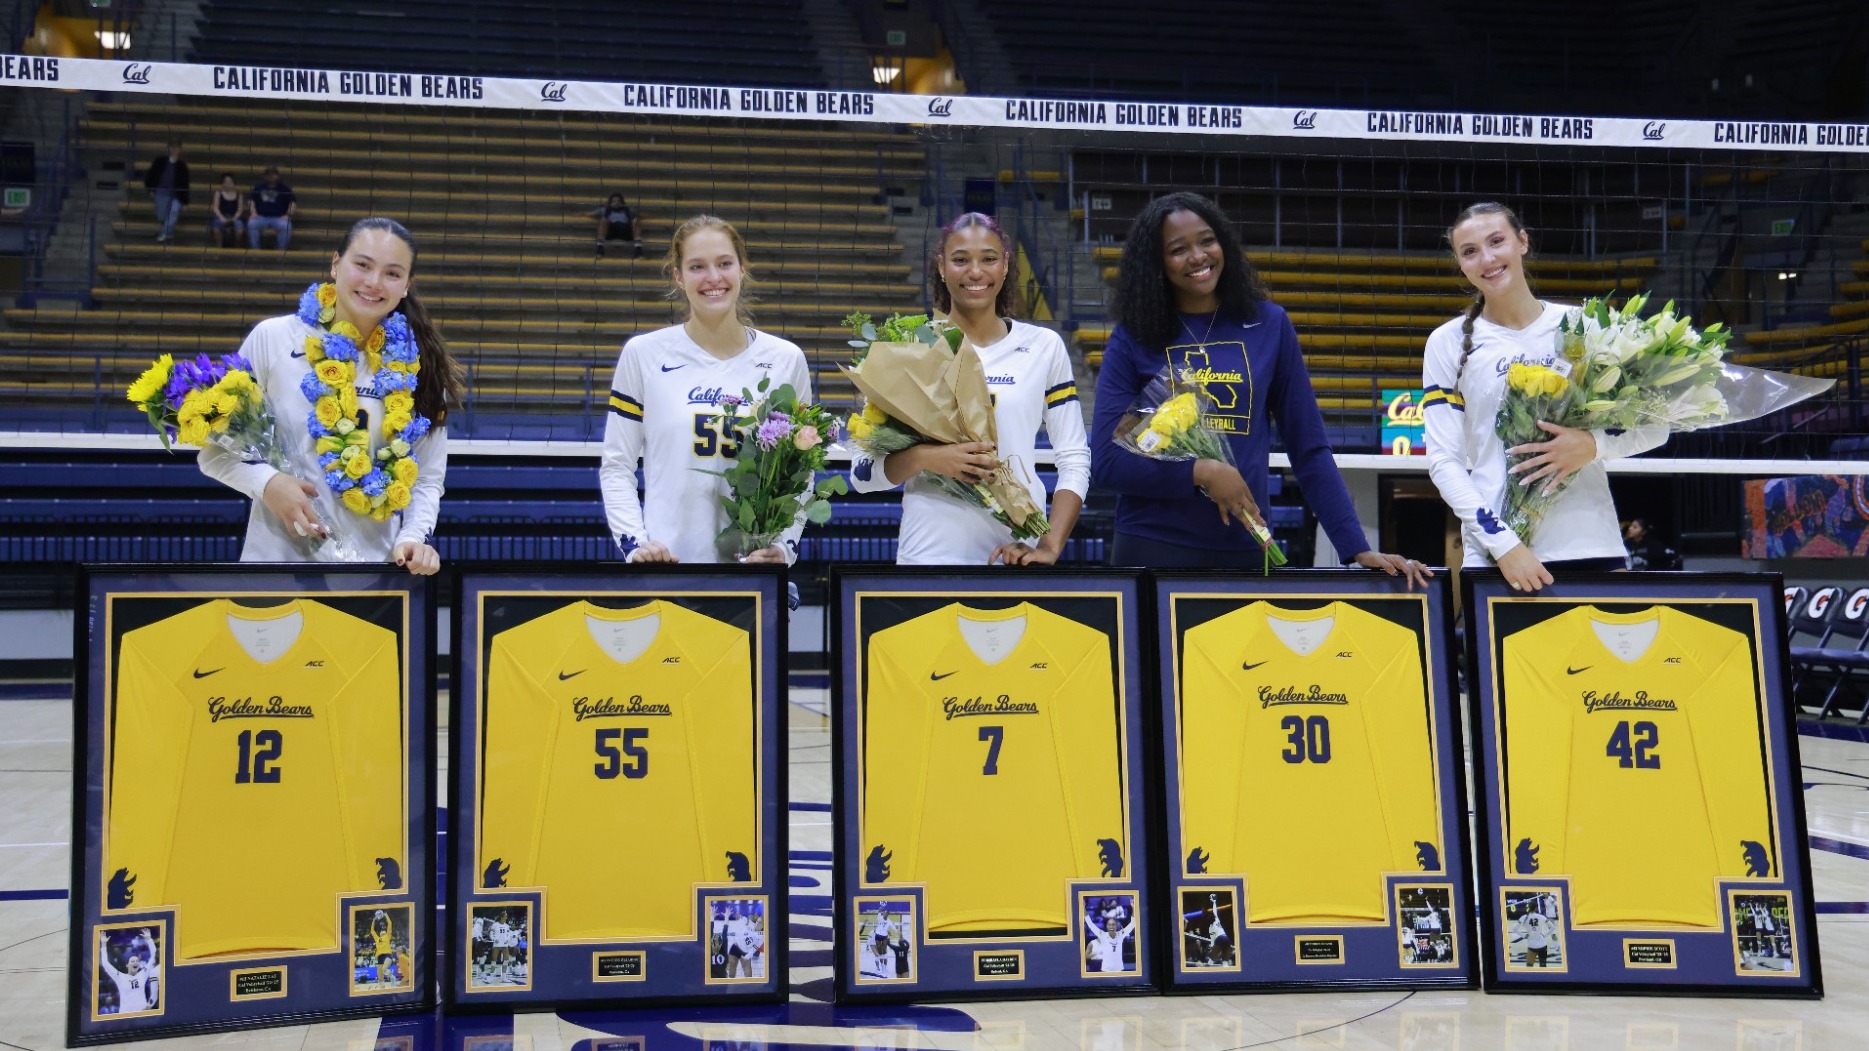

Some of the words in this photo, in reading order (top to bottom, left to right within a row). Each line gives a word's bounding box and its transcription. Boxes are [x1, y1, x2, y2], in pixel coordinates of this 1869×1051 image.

[122, 62, 152, 85] Cal
[213, 66, 330, 94] CALIFORNIA
[340, 71, 412, 97] GOLDEN
[421, 75, 484, 100] BEARS
[540, 81, 568, 103] Cal
[624, 84, 731, 110] CALIFORNIA
[740, 89, 808, 113] GOLDEN
[816, 92, 874, 115] BEARS
[928, 97, 953, 117] Cal
[1005, 99, 1107, 124] CALIFORNIA
[1115, 103, 1180, 127] GOLDEN
[1187, 106, 1243, 128] BEARS
[1293, 110, 1316, 130] Cal
[1367, 112, 1464, 135] CALIFORNIA
[1472, 115, 1533, 138] GOLDEN
[1540, 117, 1593, 140] BEARS
[1642, 121, 1666, 141] Cal
[1714, 122, 1808, 145] CALIFORNIA
[1816, 124, 1869, 147] GOLDE
[1181, 366, 1243, 386] California
[693, 412, 746, 459] 55
[1205, 417, 1237, 431] LEYBALL
[305, 660, 325, 668] ACC
[662, 656, 681, 664] ACC
[207, 696, 263, 723] Golden
[265, 695, 314, 718] Bears
[572, 696, 626, 722] Golden
[627, 694, 672, 717] Bears
[942, 696, 992, 721] Golden
[995, 694, 1039, 715] Bears
[1257, 685, 1305, 709] Golden
[1306, 684, 1349, 705] Bears
[1581, 690, 1632, 714] Golden
[1633, 690, 1678, 711] Bears
[978, 725, 1004, 776] 7
[1281, 714, 1331, 764] 30
[1606, 720, 1661, 770] 42
[235, 729, 283, 784] 12
[594, 727, 649, 780] 55
[1529, 917, 1539, 927] 42
[711, 953, 725, 965] 10
[130, 980, 140, 990] 12
